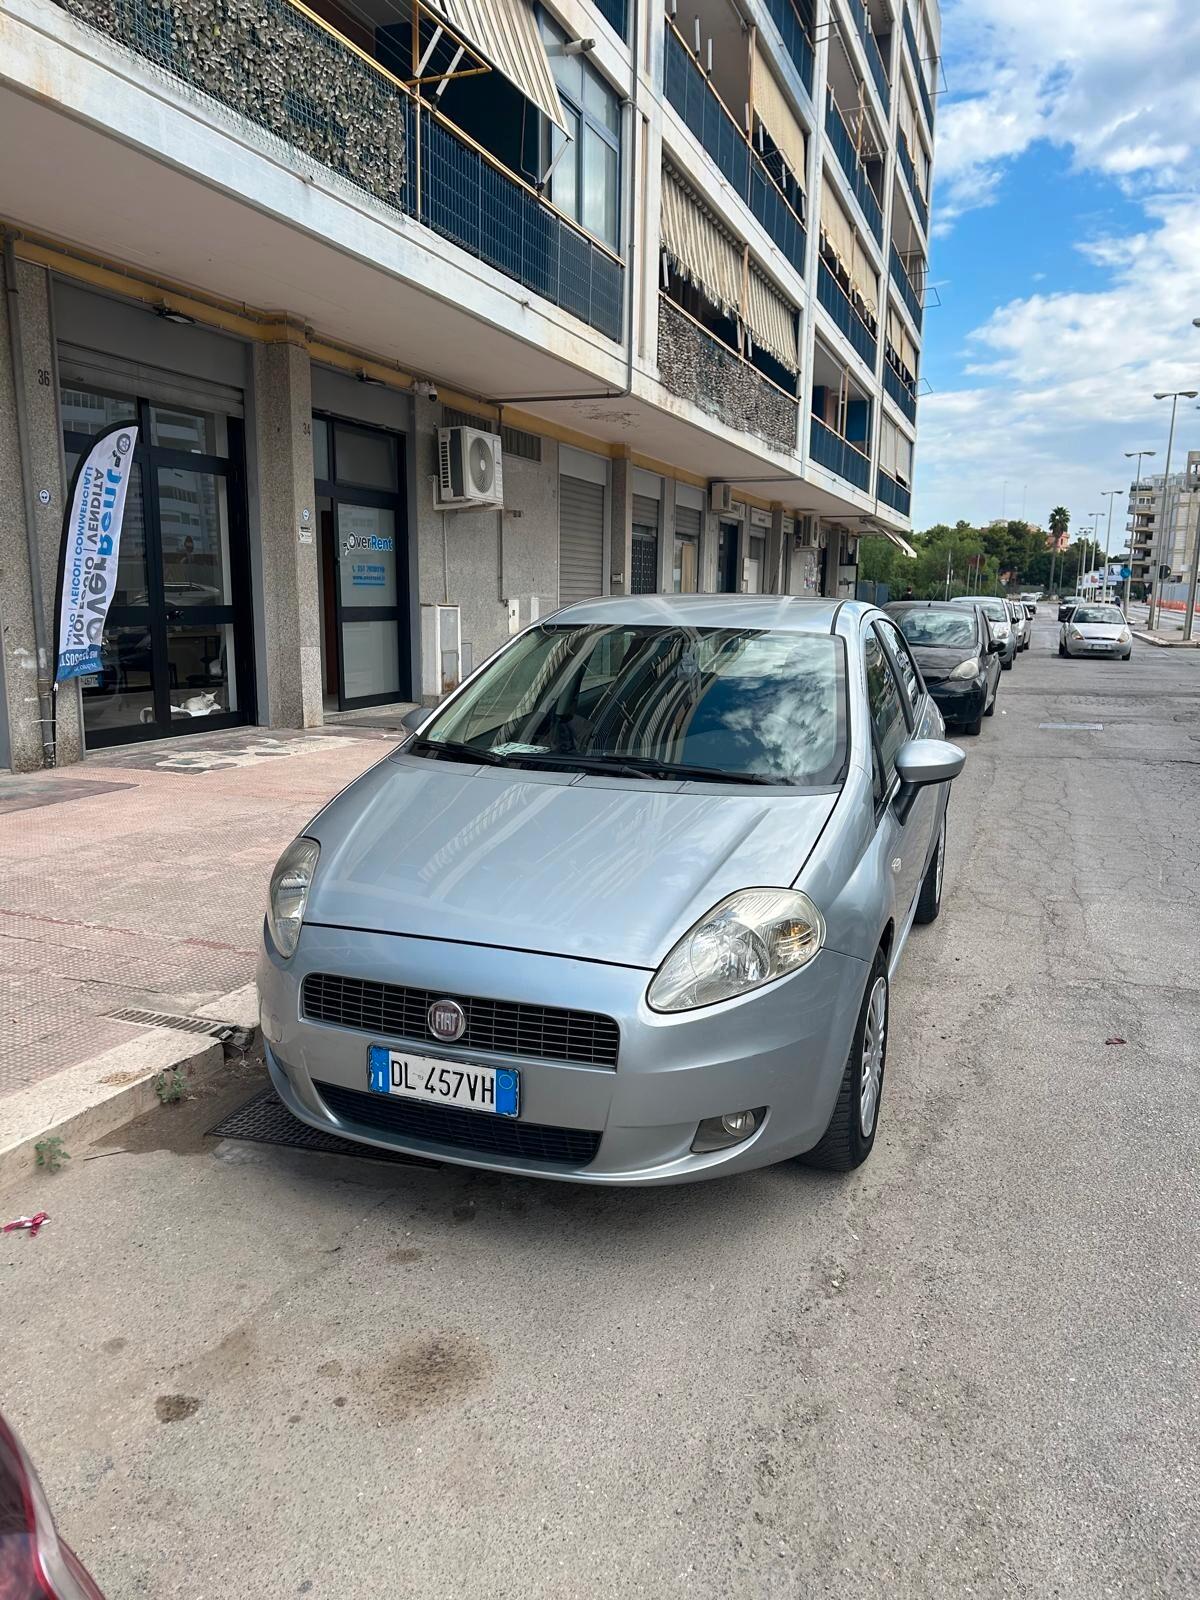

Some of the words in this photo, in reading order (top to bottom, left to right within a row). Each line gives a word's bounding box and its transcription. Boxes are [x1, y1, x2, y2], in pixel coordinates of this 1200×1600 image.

[37, 369, 50, 387] 36
[303, 422, 311, 436] 34
[349, 533, 393, 551] OverRent
[435, 1011, 457, 1031] FIAT
[391, 1060, 417, 1090] DL
[424, 1067, 494, 1104] 457VH
